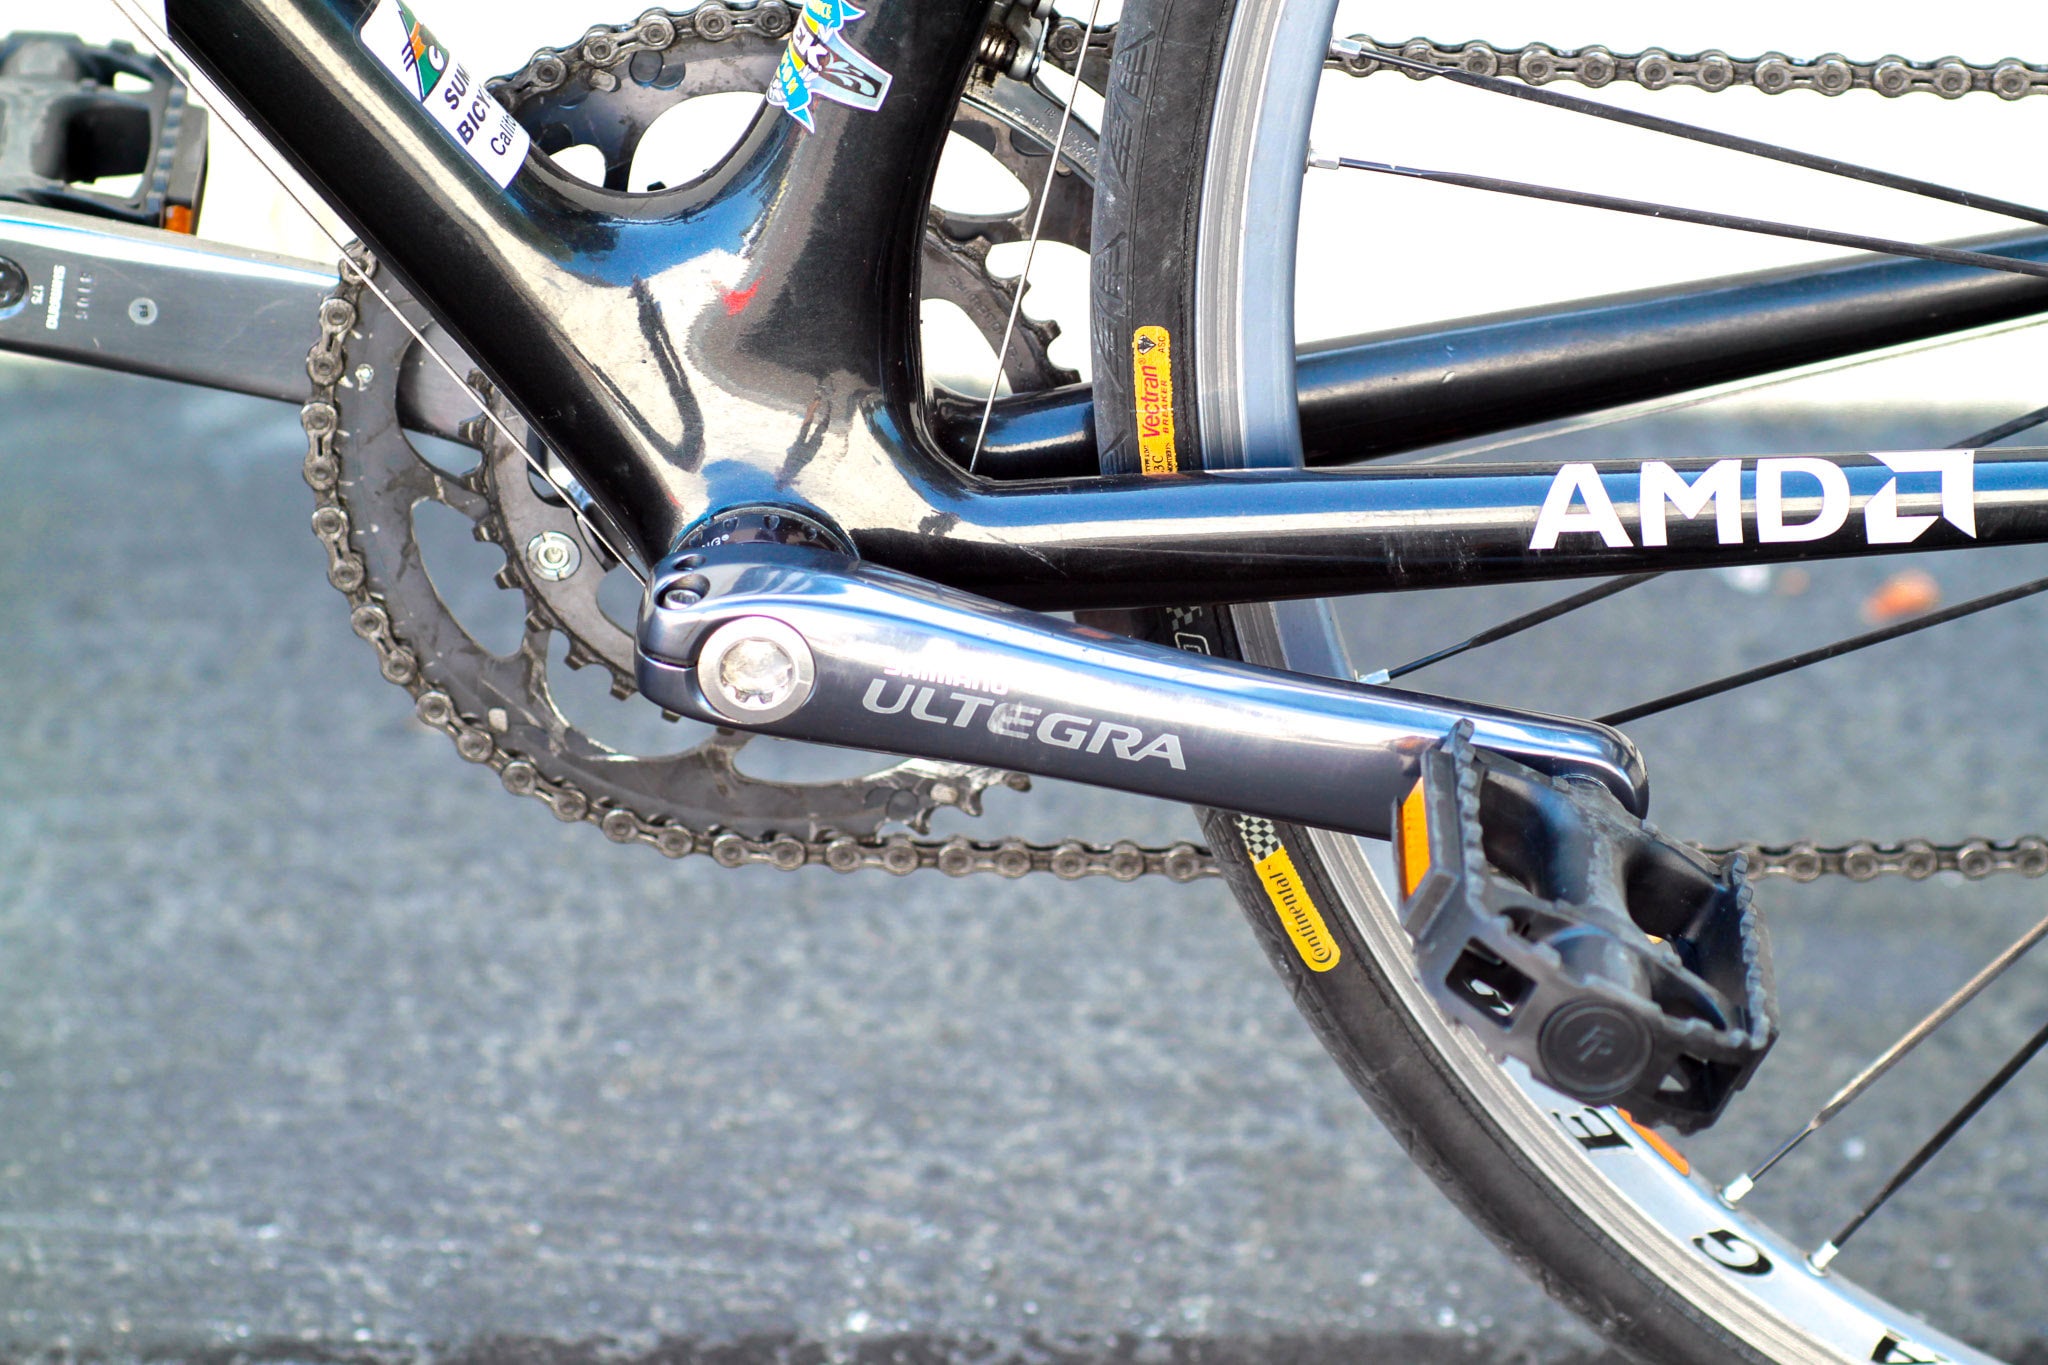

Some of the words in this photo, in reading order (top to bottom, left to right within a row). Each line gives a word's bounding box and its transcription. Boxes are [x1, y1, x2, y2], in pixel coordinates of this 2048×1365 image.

[1162, 379, 1171, 434] BREAKER
[1528, 457, 1851, 550] AMD
[862, 678, 1187, 771] ULTEGRA
[1269, 872, 1332, 964] Continental
